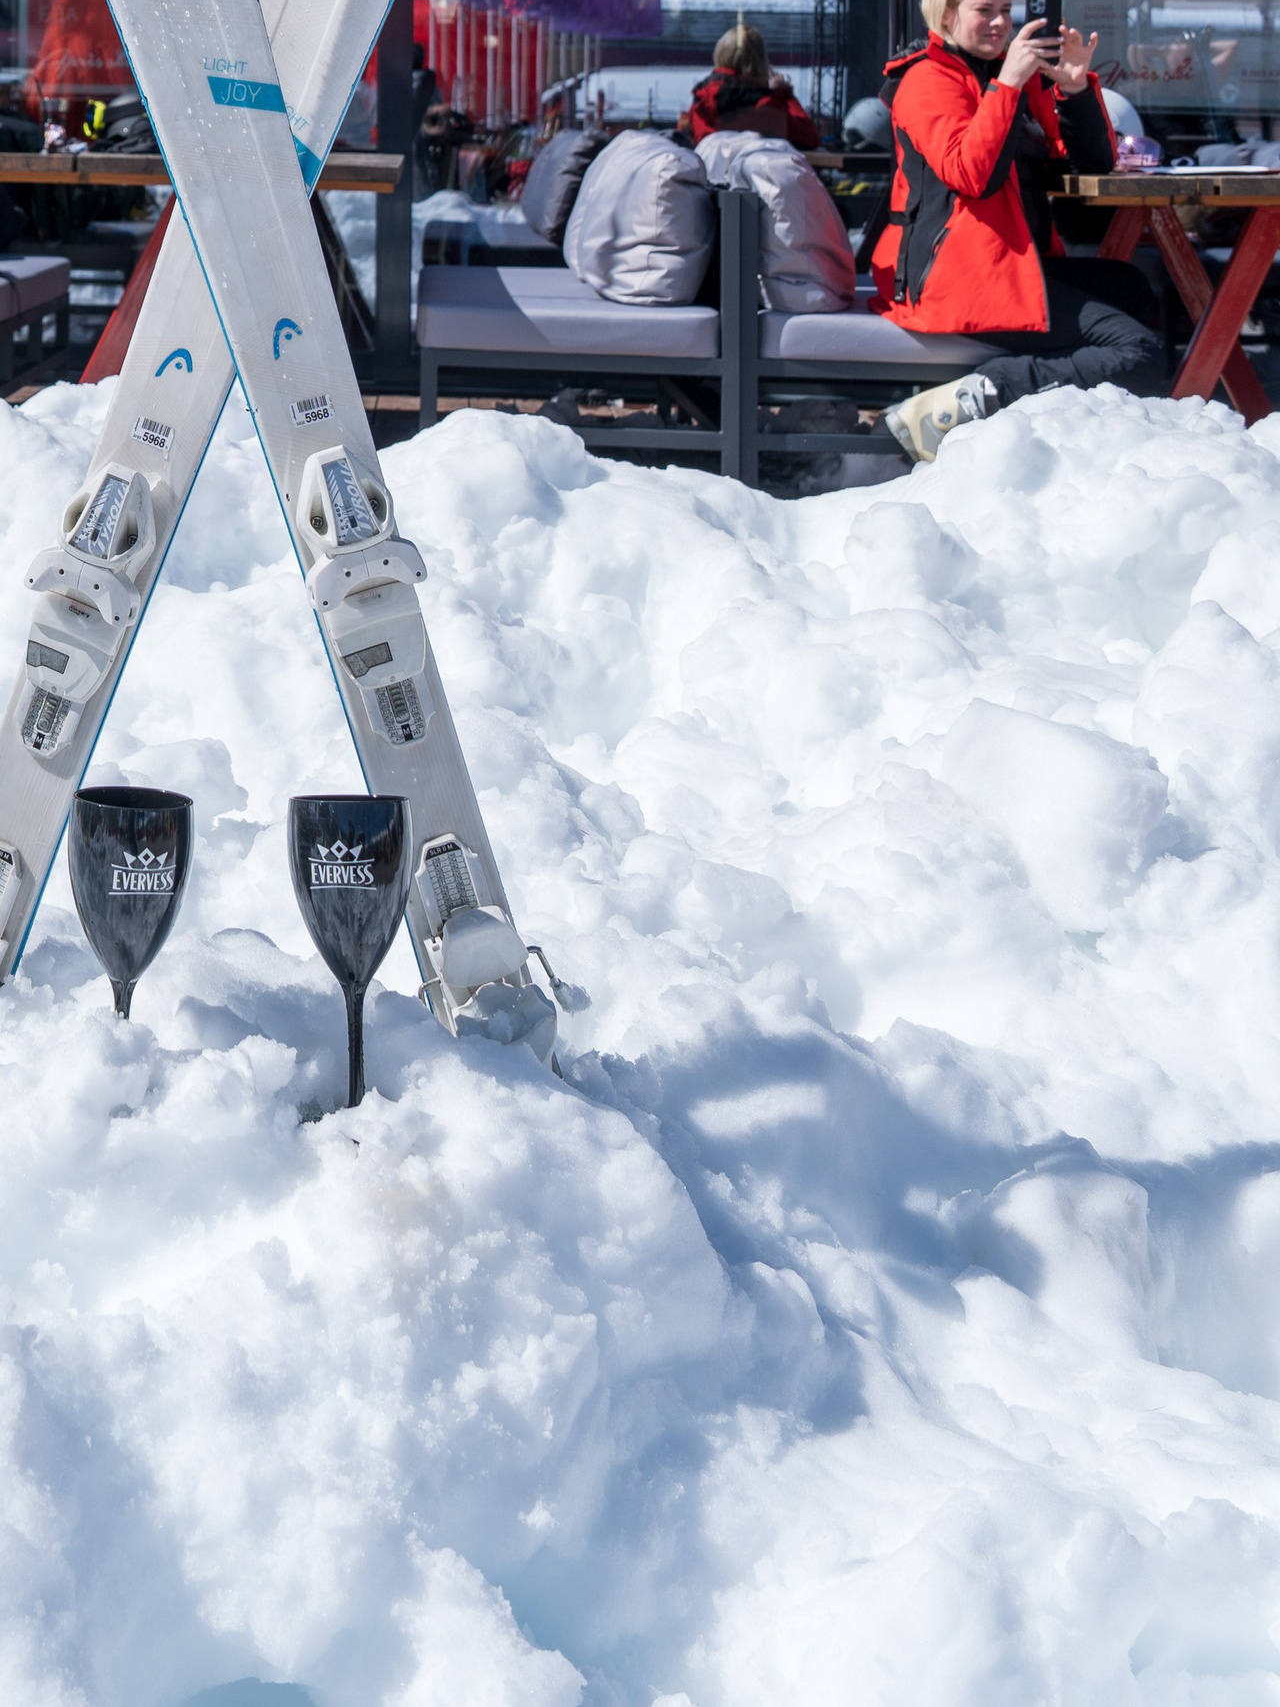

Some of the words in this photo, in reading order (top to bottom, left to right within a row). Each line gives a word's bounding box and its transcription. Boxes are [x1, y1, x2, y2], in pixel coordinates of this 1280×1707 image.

[203, 56, 248, 74] LIGHT
[224, 82, 262, 104] JOY
[285, 102, 310, 131] GHT
[305, 408, 330, 423] 5968
[142, 431, 166, 448] 5968
[112, 869, 174, 892] EVERVESS
[310, 862, 375, 886] EVERVESS
